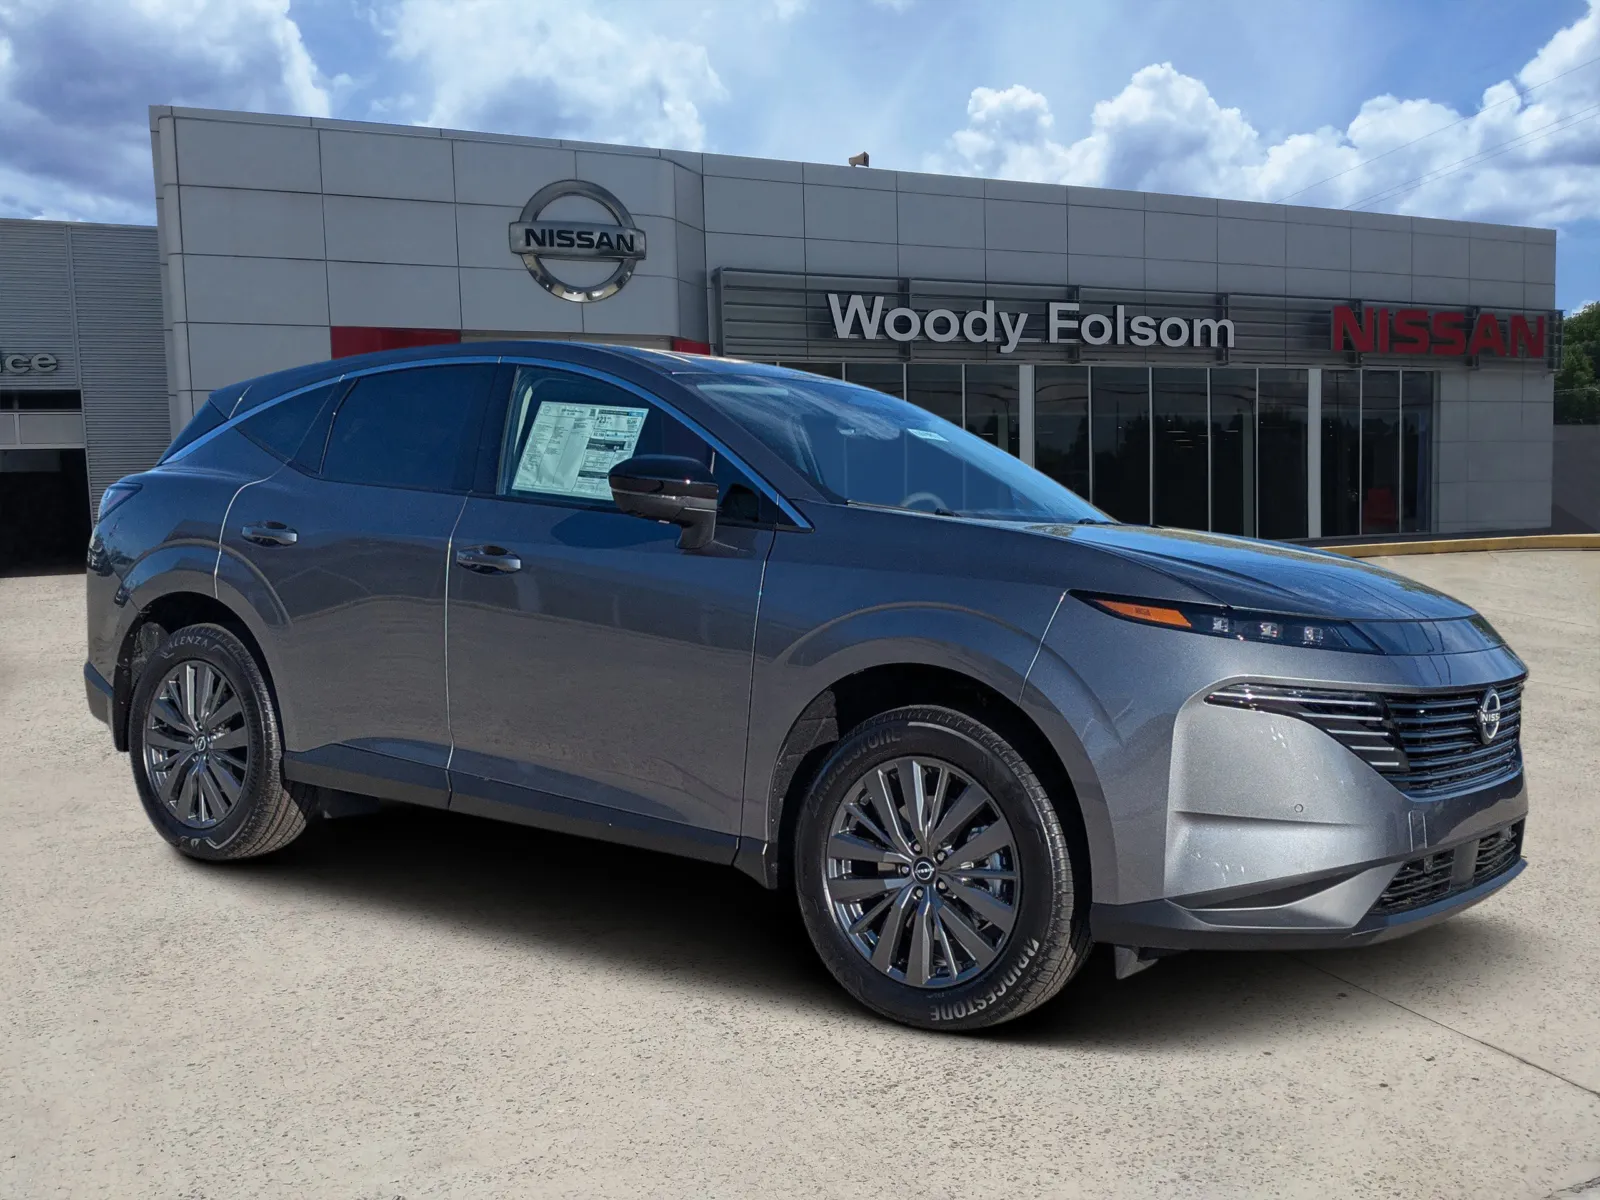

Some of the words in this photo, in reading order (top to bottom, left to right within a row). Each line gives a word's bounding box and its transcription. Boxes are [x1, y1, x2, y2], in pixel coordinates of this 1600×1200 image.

[524, 228, 635, 252] NISSAN
[827, 293, 1028, 353] Woody
[1047, 302, 1235, 347] Folsom
[1332, 305, 1545, 358] NISSAN
[0, 353, 57, 373] ce
[930, 938, 1040, 1021] BRIDGESTONE
